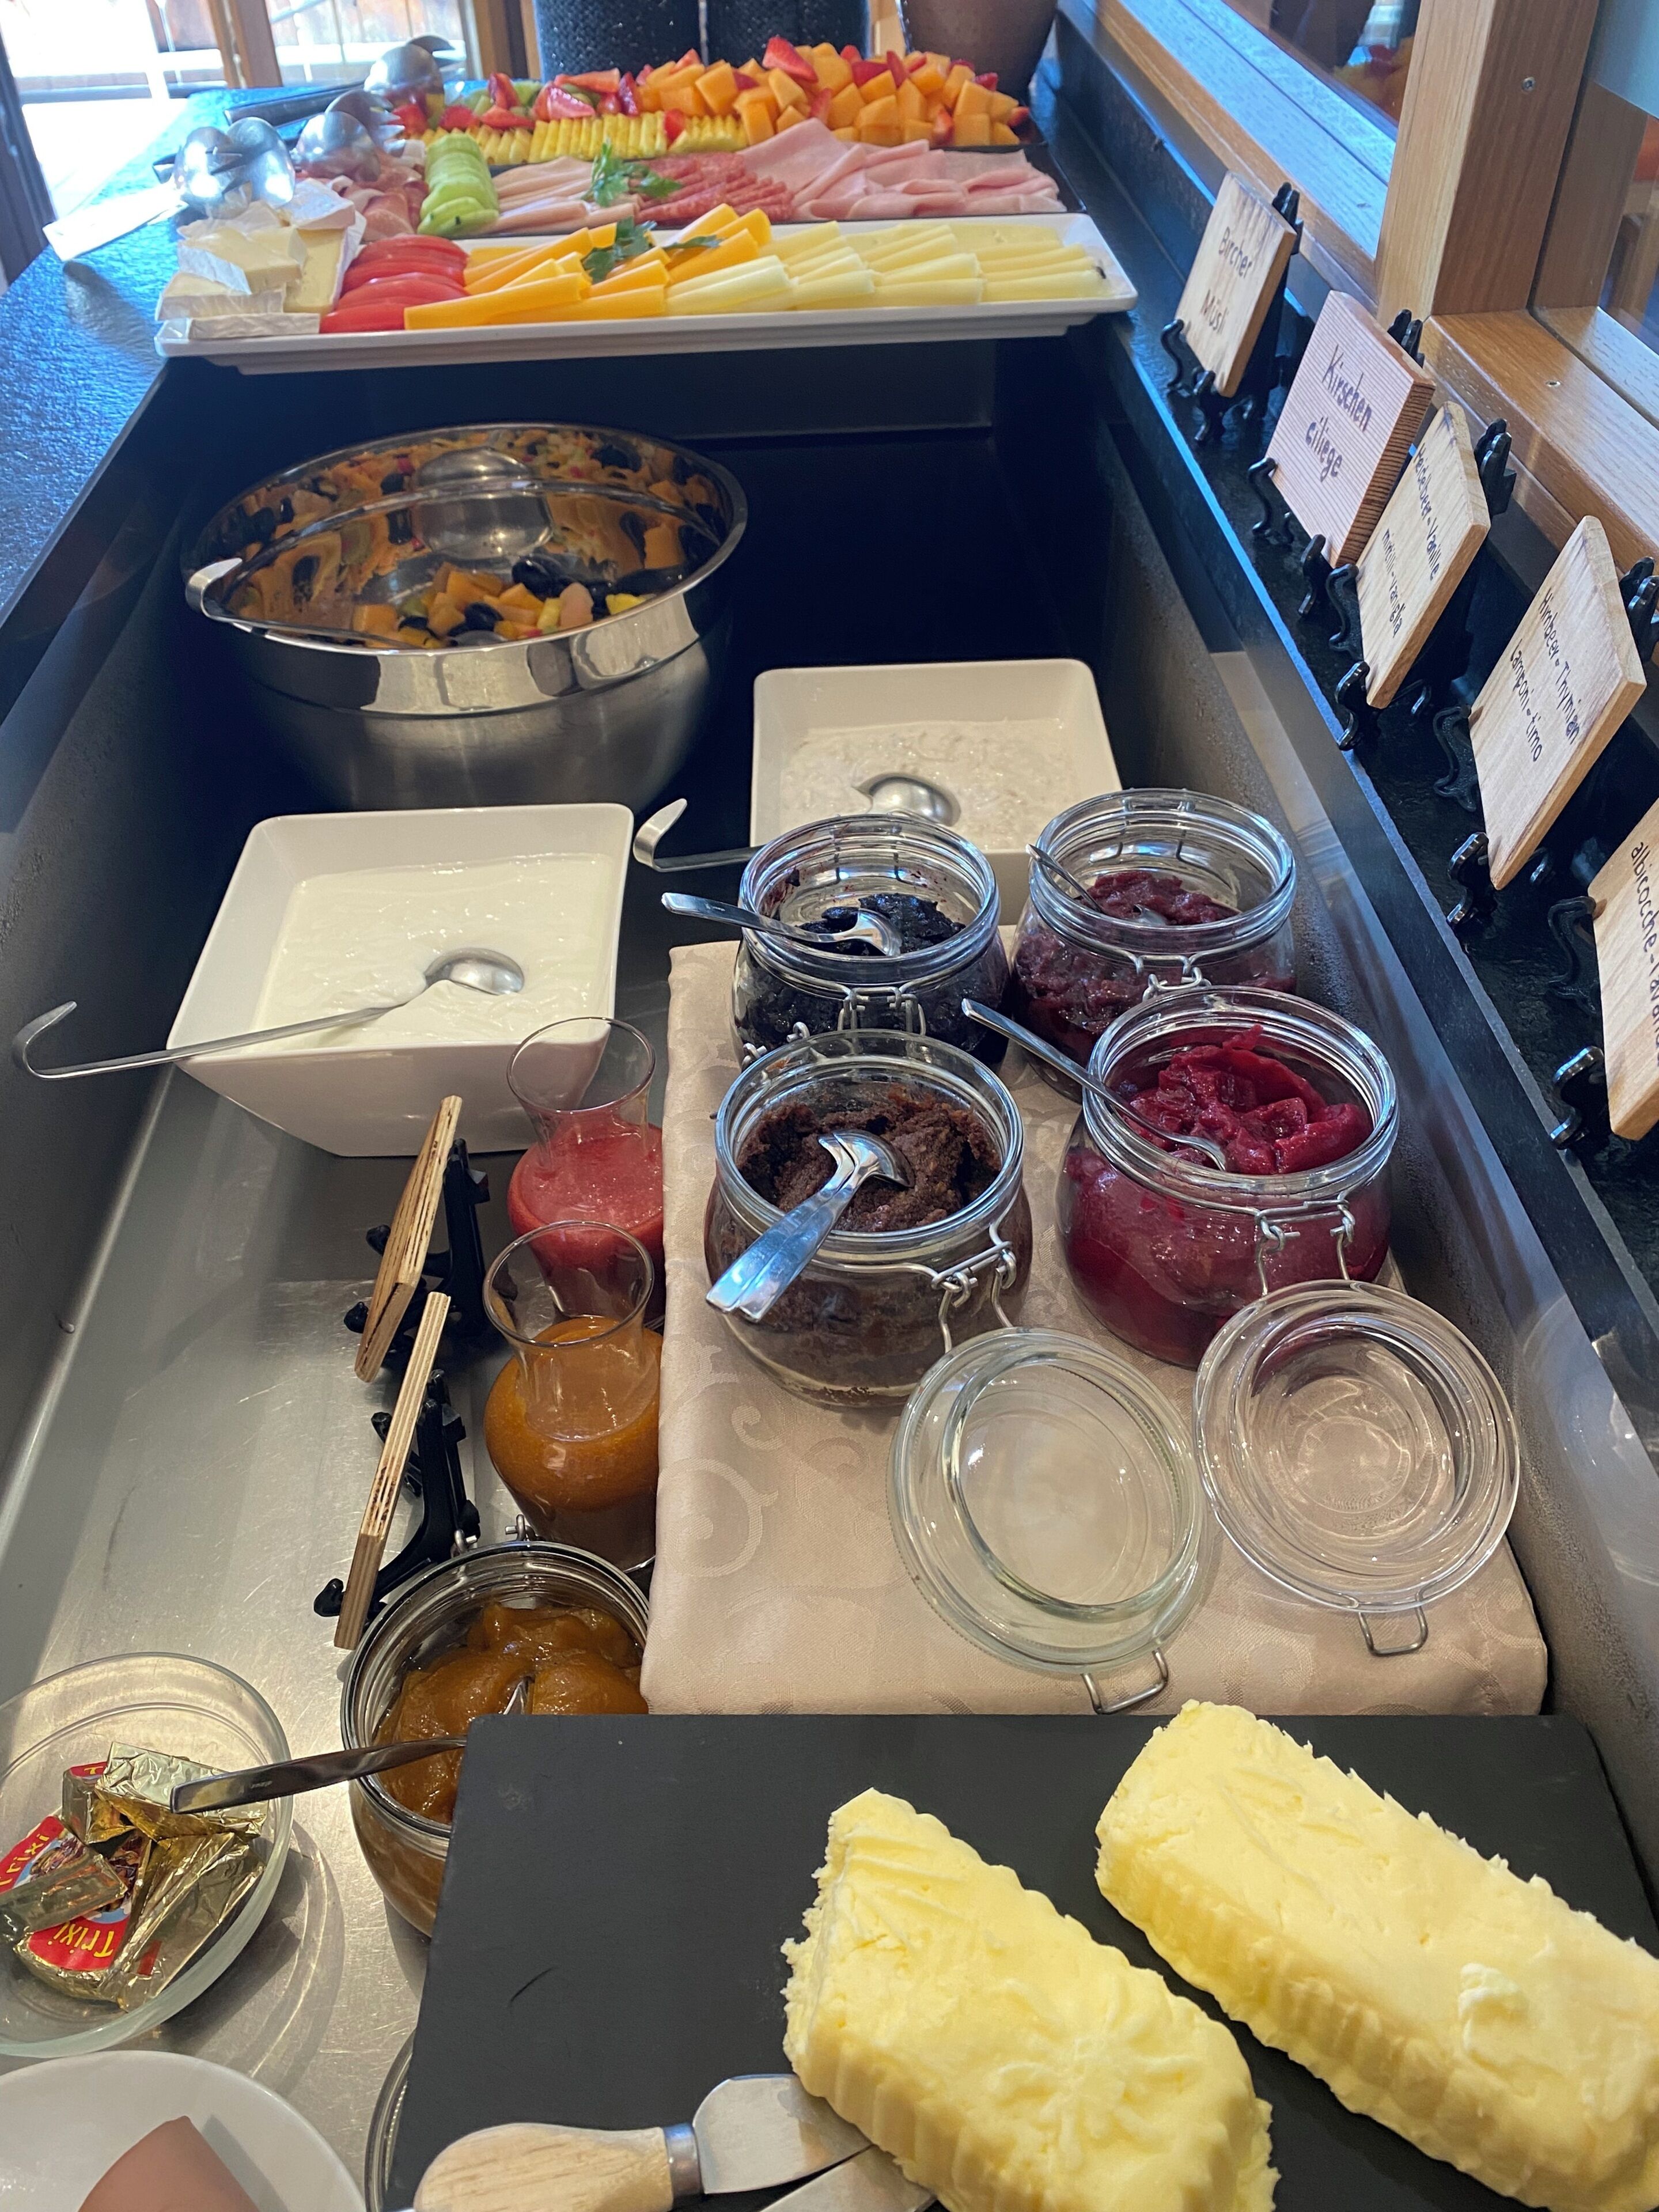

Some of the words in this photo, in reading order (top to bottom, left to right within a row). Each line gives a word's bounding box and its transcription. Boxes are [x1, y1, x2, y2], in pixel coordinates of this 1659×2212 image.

[1218, 226, 1253, 279] Bircher
[1200, 289, 1230, 334] Müsli
[1321, 344, 1372, 432] Kirschen
[1305, 416, 1343, 483] ciliege
[1413, 442, 1432, 521] Heidelbeer
[1427, 517, 1441, 581] Vanille
[1382, 528, 1396, 575] mirtilli
[1389, 575, 1406, 638] vaniglia
[1538, 587, 1559, 660] Himbeer
[1555, 661, 1581, 745] Thymian
[1527, 712, 1543, 762] timo
[1631, 842, 1659, 952] albicocche
[47, 1922, 115, 1957] Trixi
